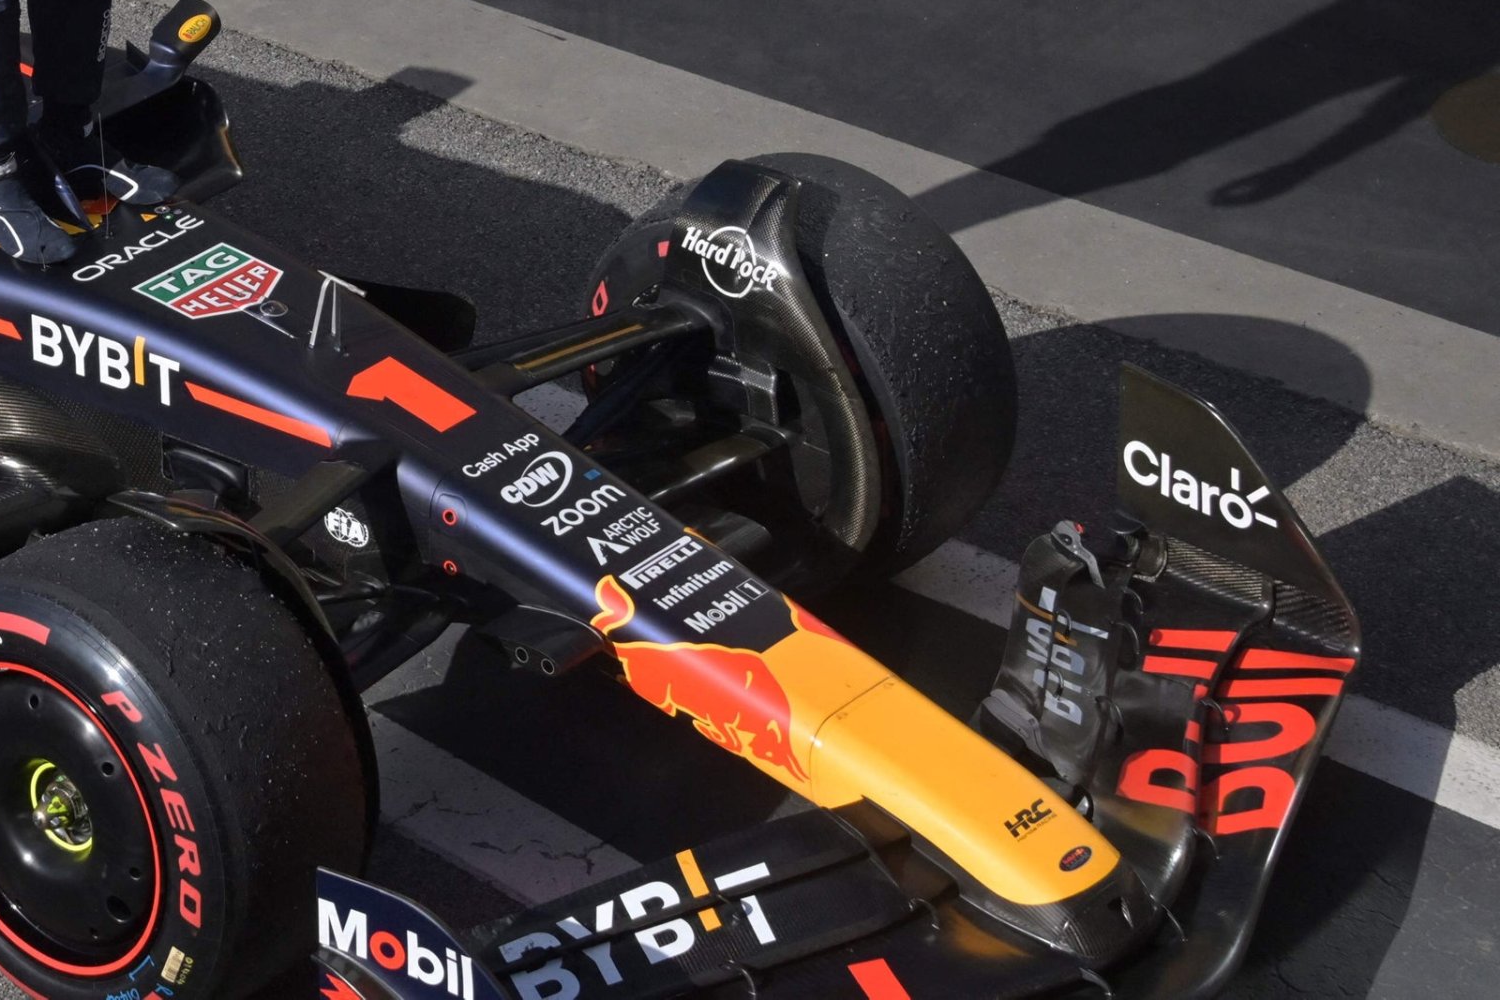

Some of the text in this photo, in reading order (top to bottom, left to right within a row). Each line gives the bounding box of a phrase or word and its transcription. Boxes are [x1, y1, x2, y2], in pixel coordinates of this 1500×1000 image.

[72, 214, 204, 282] ORACLE
[148, 250, 240, 294] TAG
[681, 226, 778, 292] Hard Rock
[180, 265, 270, 314] HEUER
[30, 314, 180, 406] BYBIT
[462, 432, 540, 478] Cash App
[500, 462, 561, 504] CDW
[1123, 440, 1257, 529] Claro
[540, 483, 627, 536] zoom
[603, 506, 653, 541] ARCTIC
[619, 518, 661, 547] WOLF
[619, 534, 703, 590] PIRELLI
[653, 559, 735, 611] infinitum
[684, 589, 750, 634] Mobil
[101, 690, 143, 723] P
[137, 742, 201, 928] ZERO
[1004, 799, 1053, 838] HRC
[317, 897, 474, 1000] Mobil
